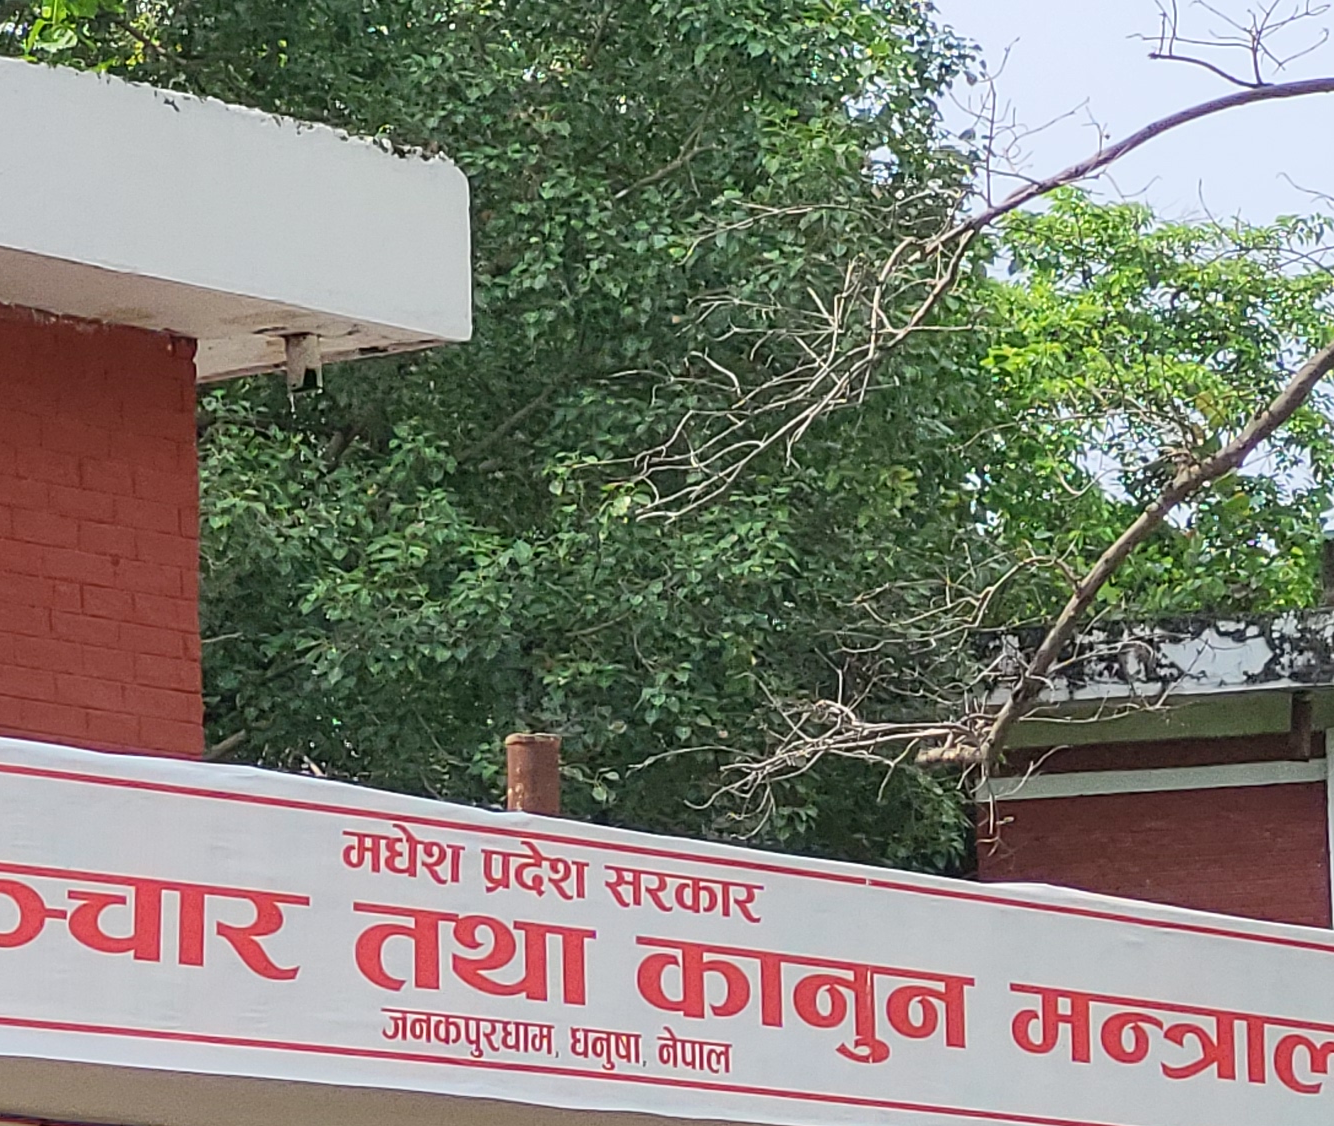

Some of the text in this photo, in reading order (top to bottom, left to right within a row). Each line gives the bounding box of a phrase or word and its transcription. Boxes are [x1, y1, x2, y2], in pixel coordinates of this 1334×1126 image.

[342, 824, 765, 923] मधेश प्रदेश सरकार
[353, 902, 597, 1006] तथा
[635, 937, 976, 1063] कानुन
[381, 1008, 733, 1073] जनकपुरधाम, धनुषा, नेपाल
